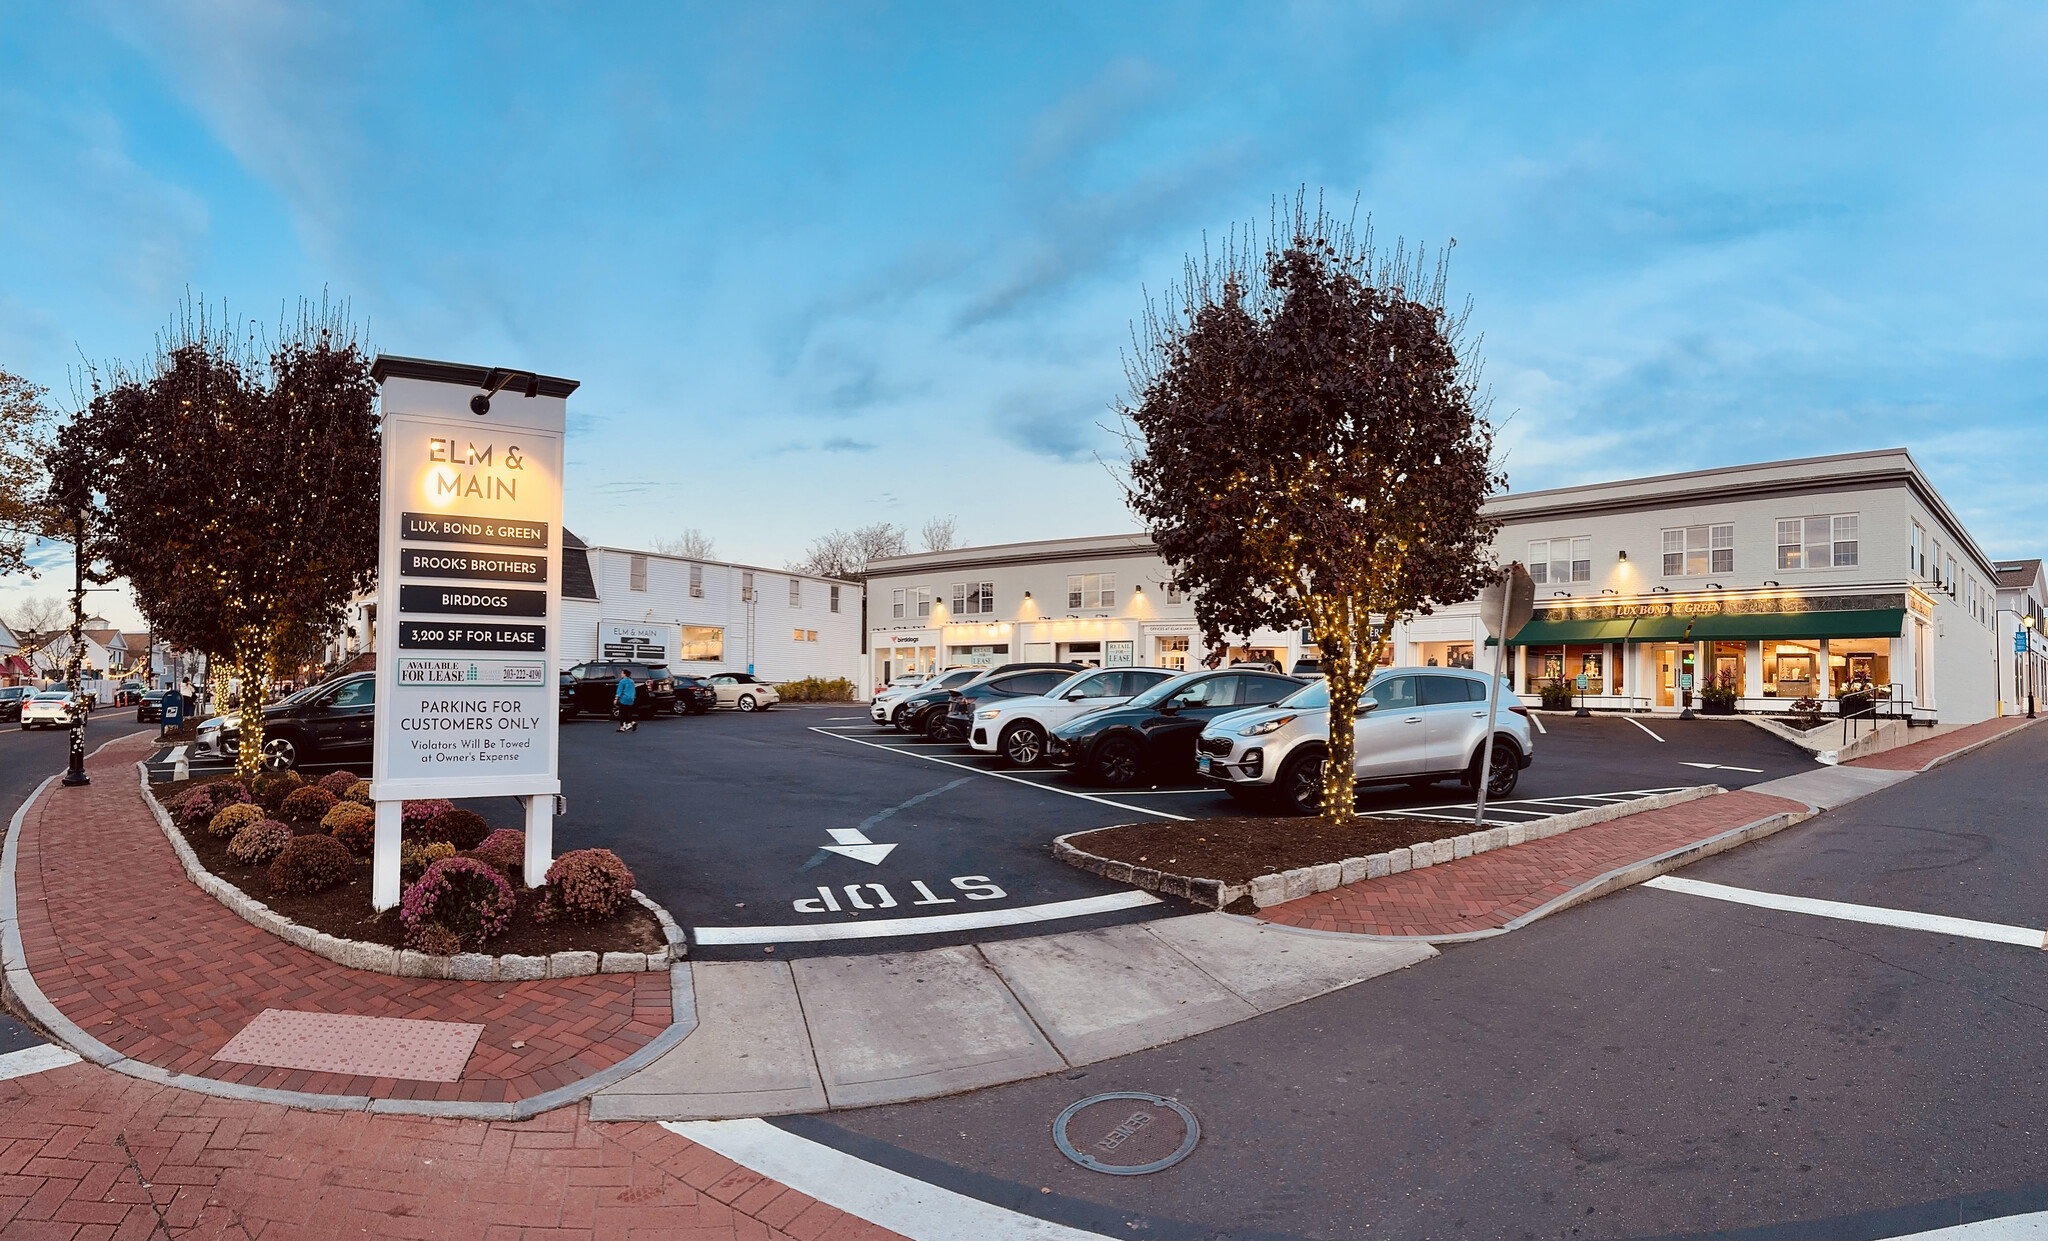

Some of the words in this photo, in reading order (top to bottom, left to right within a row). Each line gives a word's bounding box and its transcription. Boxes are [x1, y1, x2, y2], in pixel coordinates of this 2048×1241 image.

[429, 437, 493, 467] ELM
[504, 445, 524, 470] &
[437, 471, 517, 501] MAIN
[410, 520, 439, 535] LUX,
[443, 523, 481, 537] BOND
[485, 525, 494, 537] &
[498, 526, 541, 540] GREEN
[413, 556, 467, 570] BROOKS
[471, 559, 537, 574] BROTHERS
[442, 594, 508, 608] BIRDDOGS
[1617, 606, 1638, 616] LUX
[1639, 605, 1670, 615] BOND
[1672, 603, 1681, 613] &
[1684, 602, 1722, 613] GREEN
[411, 630, 444, 643] 3,200
[447, 630, 462, 641] SF
[466, 631, 492, 642] FOR
[496, 632, 535, 643] LEASE
[614, 627, 628, 636] ELM
[407, 662, 459, 670] AVAILABLE
[401, 670, 424, 682] FOR
[428, 671, 465, 682] LEASE
[503, 669, 542, 680] 203-222-4190
[421, 701, 487, 713] PARKING
[492, 701, 521, 713] FOR
[401, 718, 493, 731] CUSTOMERS
[498, 717, 540, 730] ONLY
[411, 739, 457, 750] Violators
[461, 739, 480, 749] Will
[484, 739, 496, 749] Be
[500, 738, 531, 749] Towed
[421, 754, 432, 763] at
[436, 752, 476, 762] Owner's
[479, 752, 520, 764] Expense
[792, 875, 1008, 913] STOP
[1099, 1111, 1151, 1150] SEWER
